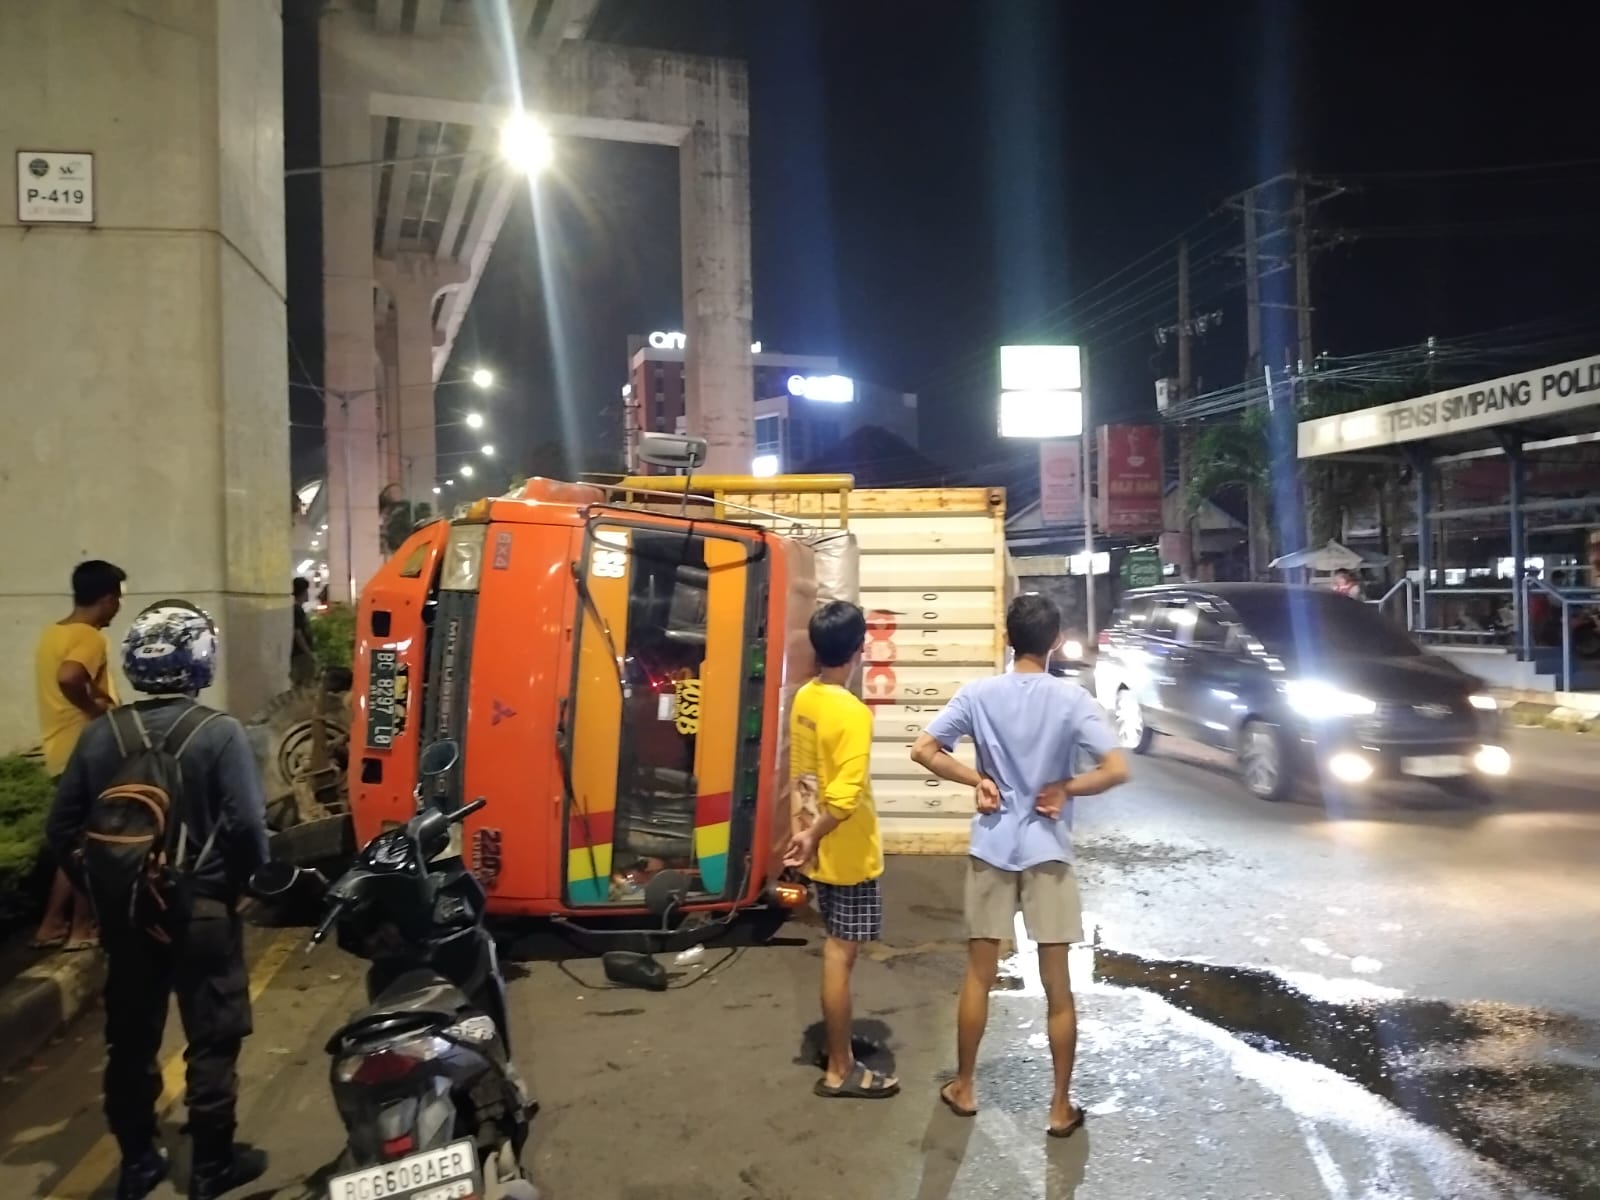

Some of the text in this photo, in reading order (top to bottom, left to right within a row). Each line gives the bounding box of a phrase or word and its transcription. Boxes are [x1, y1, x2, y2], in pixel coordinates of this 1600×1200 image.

[27, 188, 84, 204] P-419
[1442, 381, 1530, 422] SIMPANG
[440, 620, 458, 733] MITSUBISHI
[375, 678, 394, 714] 8297
